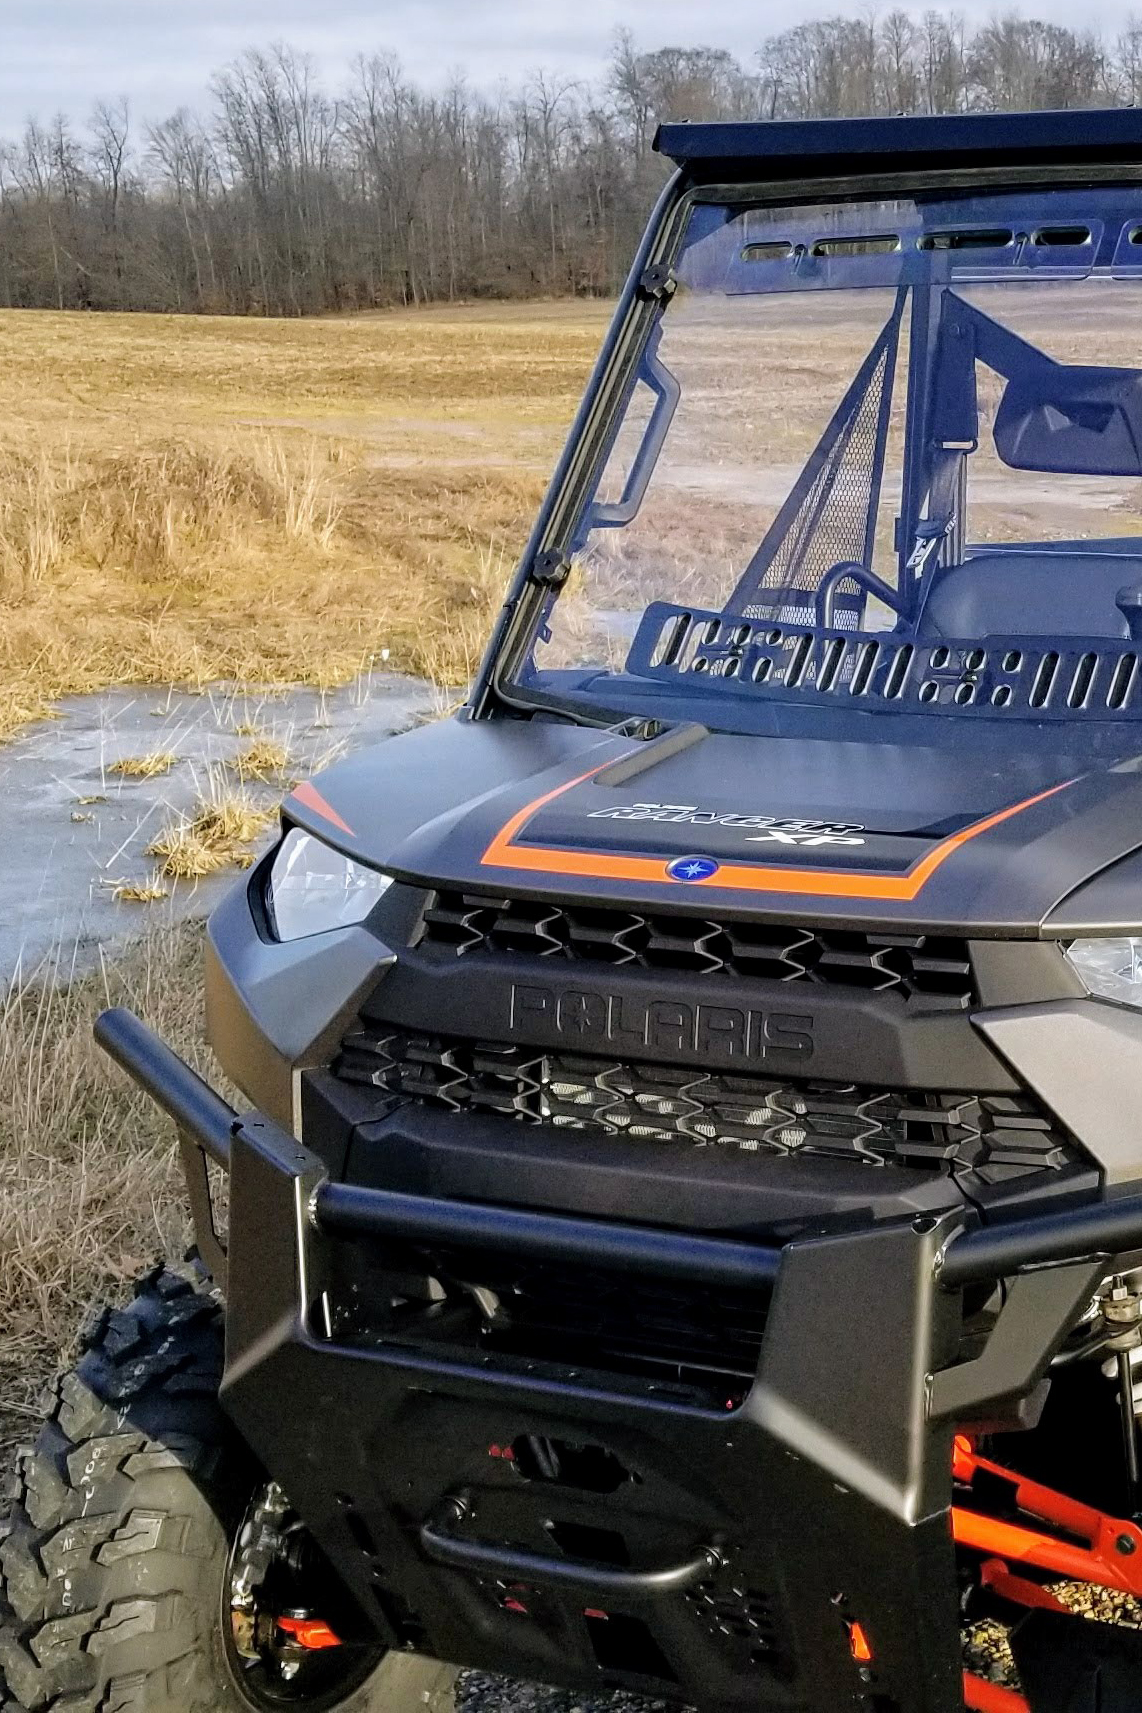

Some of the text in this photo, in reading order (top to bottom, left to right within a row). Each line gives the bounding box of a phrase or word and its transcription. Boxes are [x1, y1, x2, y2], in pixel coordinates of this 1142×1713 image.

[586, 806, 866, 836] RANGER
[744, 831, 866, 846] XP
[510, 984, 815, 1062] POLARIS
